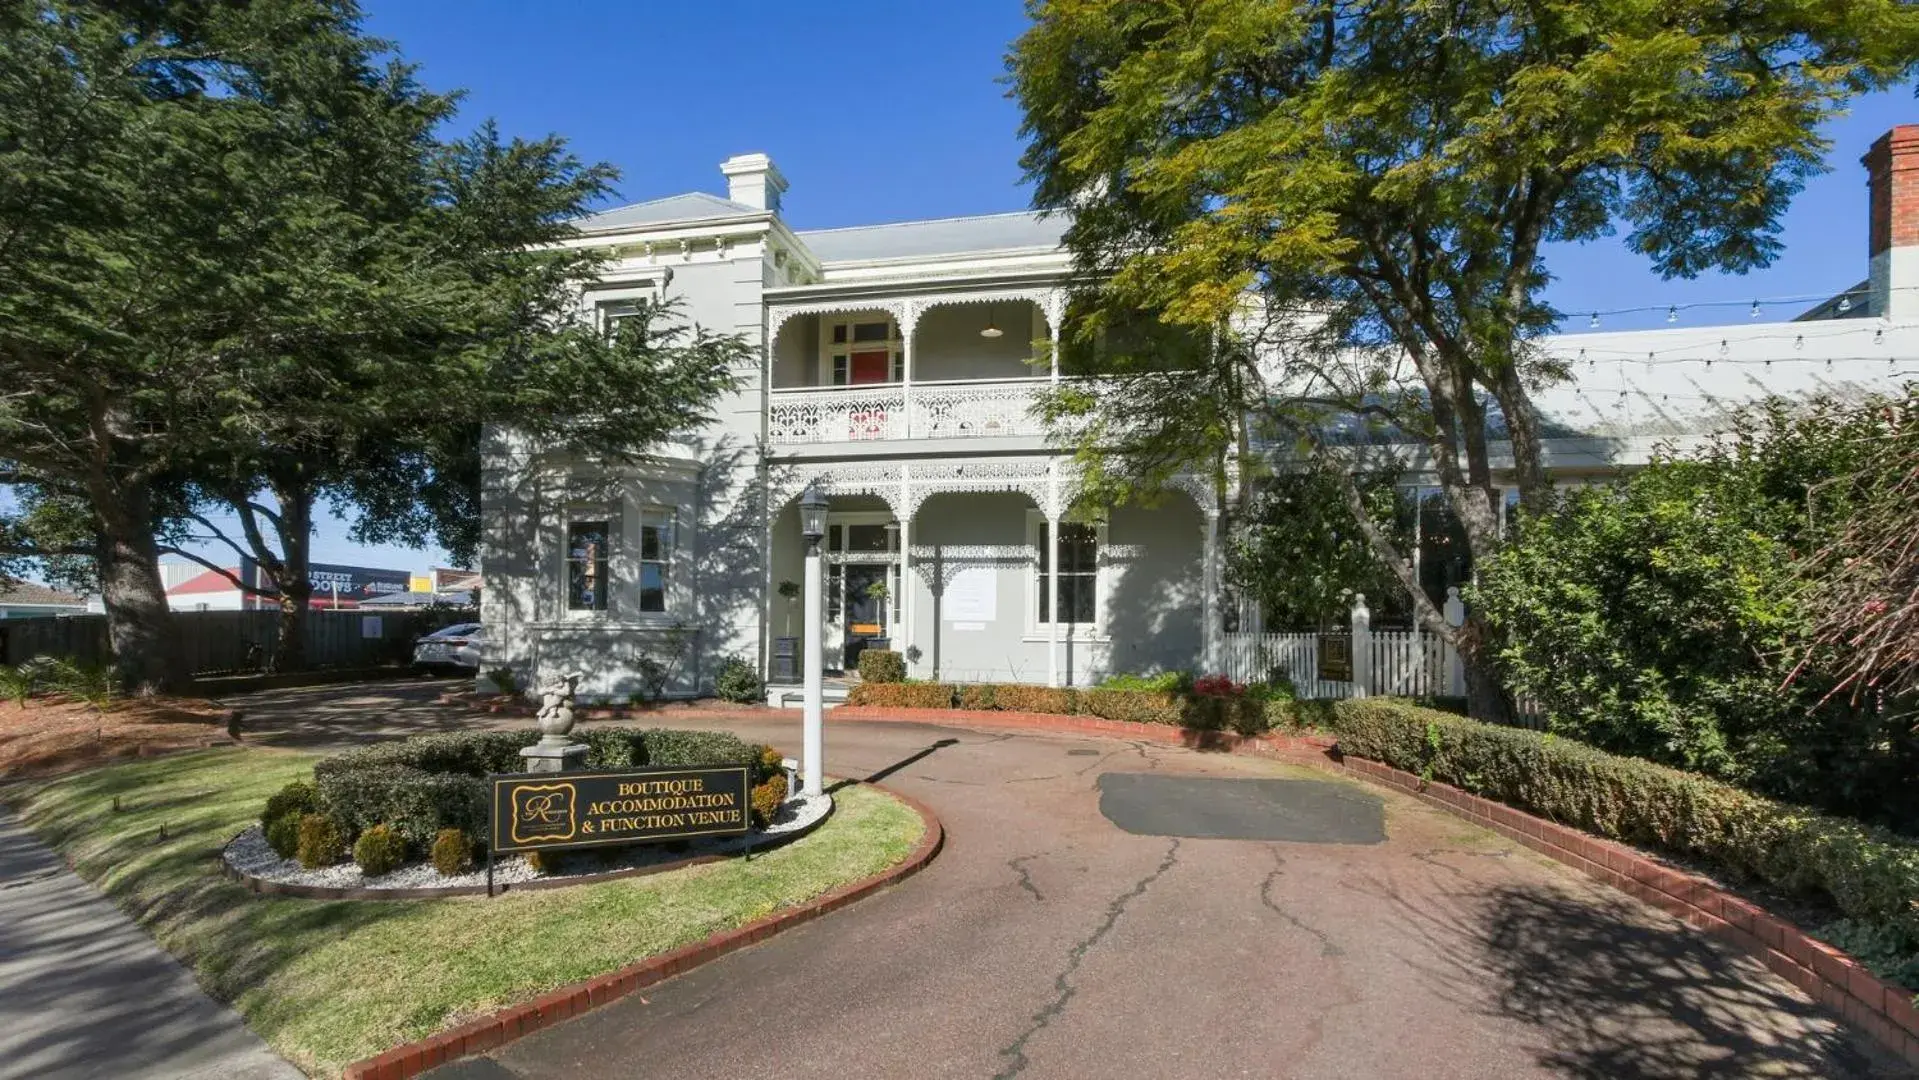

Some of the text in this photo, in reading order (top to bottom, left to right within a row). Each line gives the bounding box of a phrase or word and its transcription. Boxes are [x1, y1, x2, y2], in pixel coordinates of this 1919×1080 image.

[313, 571, 352, 581] STREET
[619, 779, 703, 796] BOUTIQUE
[587, 793, 735, 815] ACCOMMODATION
[581, 819, 595, 834] &
[601, 814, 685, 832] FUNCTION
[688, 810, 740, 825] VENUE
